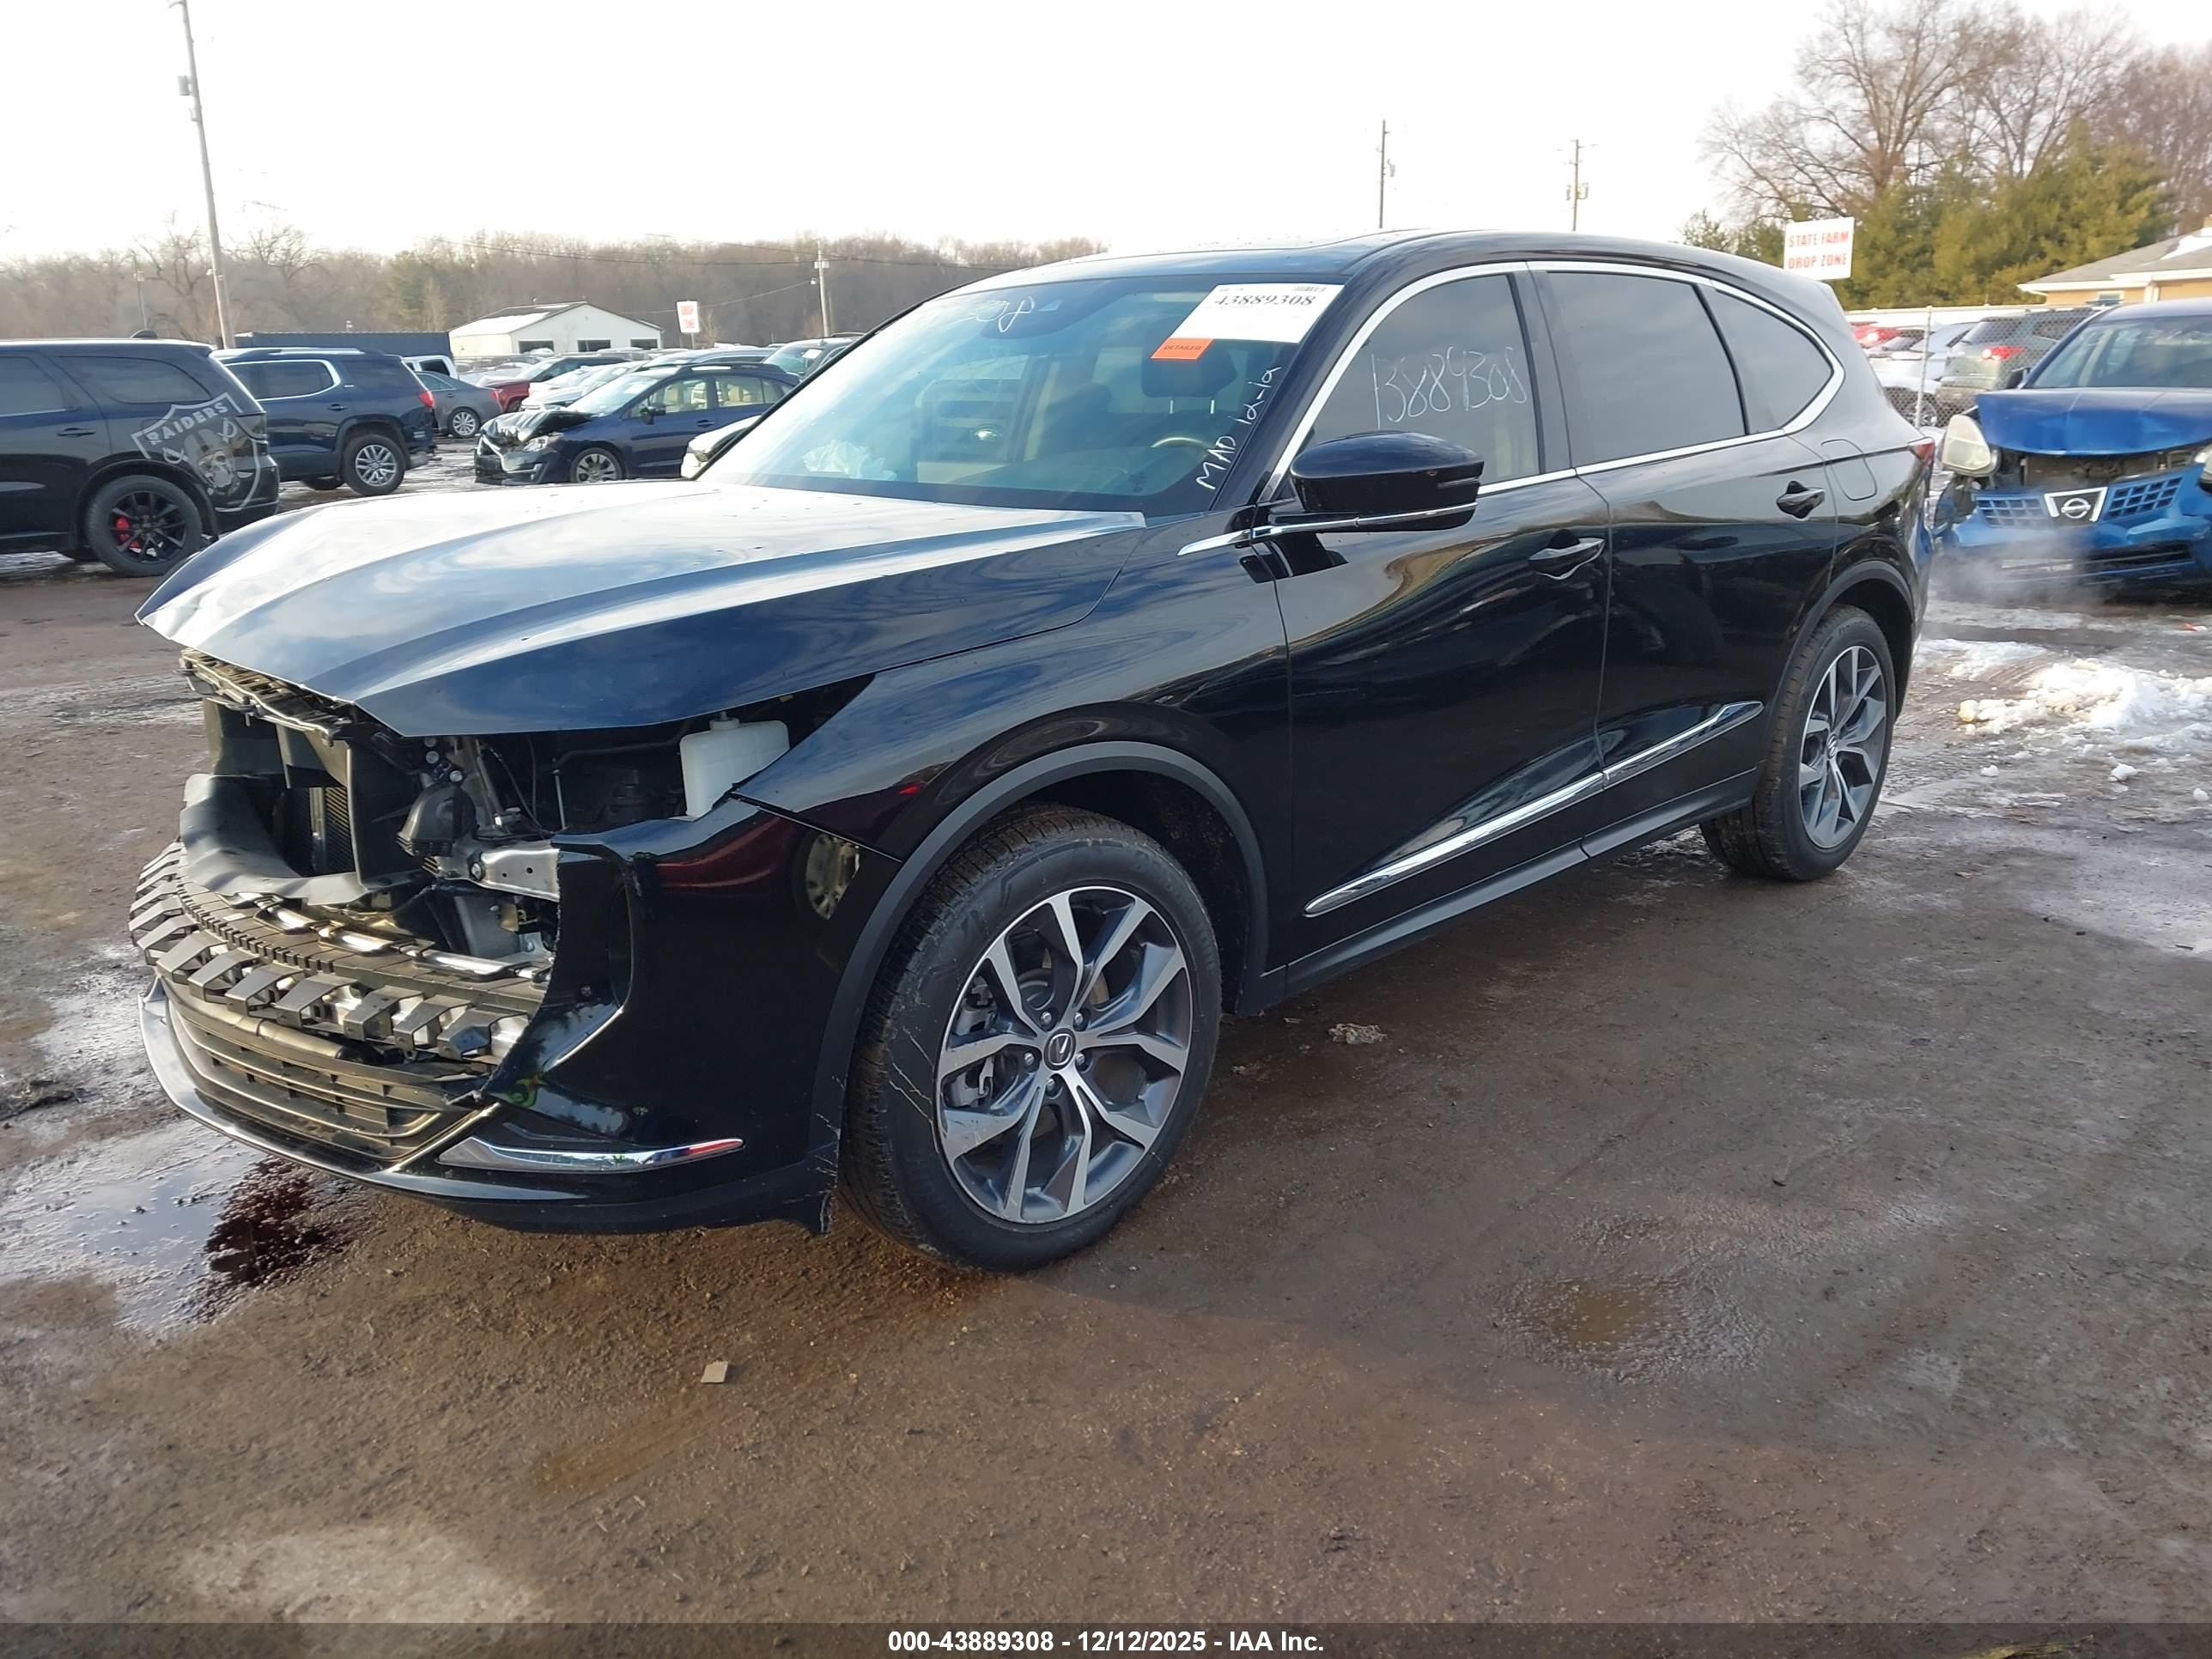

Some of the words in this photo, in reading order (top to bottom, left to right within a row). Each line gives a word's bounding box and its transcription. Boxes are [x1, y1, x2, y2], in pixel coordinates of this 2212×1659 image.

[1789, 233, 1817, 247] STATE
[1821, 231, 1849, 244] FARM
[1788, 255, 1817, 269] DROP
[1821, 252, 1847, 267] ZONE
[1213, 294, 1316, 306] 43889308
[146, 402, 228, 446] RAIDERS
